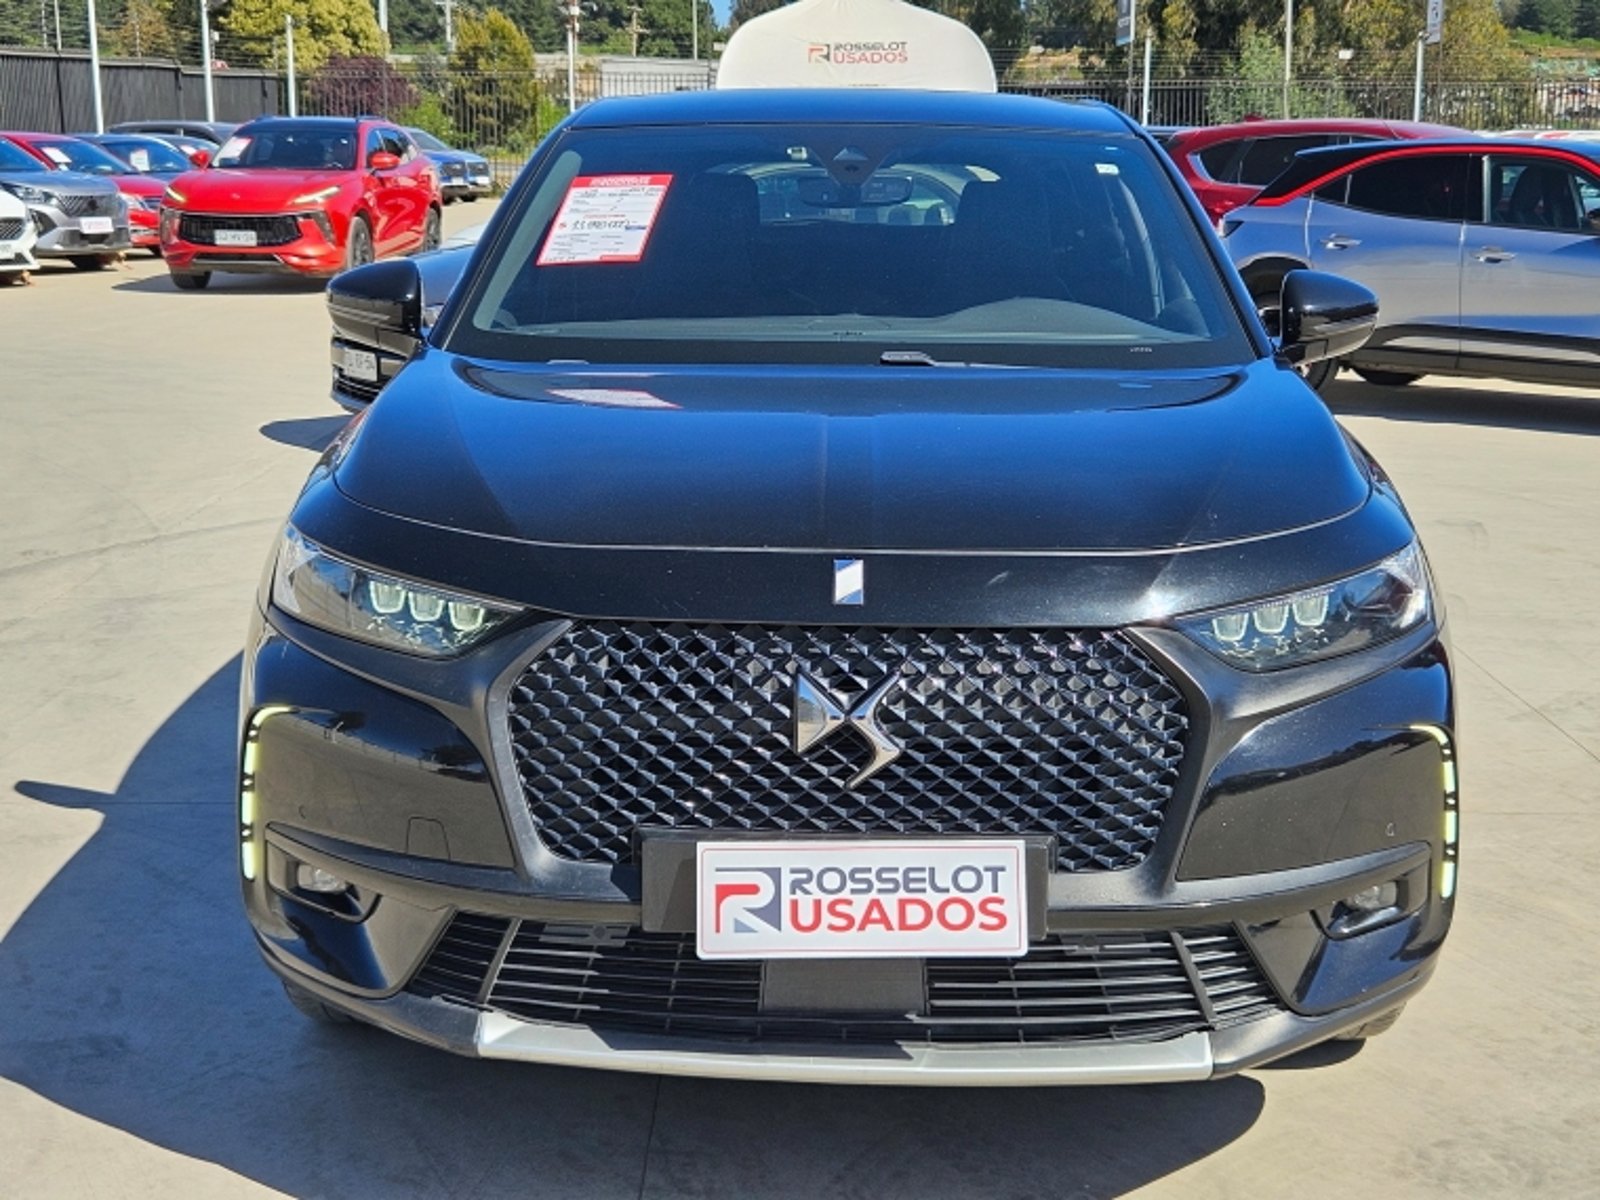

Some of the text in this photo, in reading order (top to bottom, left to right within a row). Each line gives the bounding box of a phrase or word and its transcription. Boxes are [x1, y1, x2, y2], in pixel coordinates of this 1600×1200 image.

[833, 42, 908, 51] ROSSELOT
[833, 52, 908, 64] USADOS
[789, 865, 1006, 895] ROSSELOT
[789, 897, 1008, 933] USADOS
